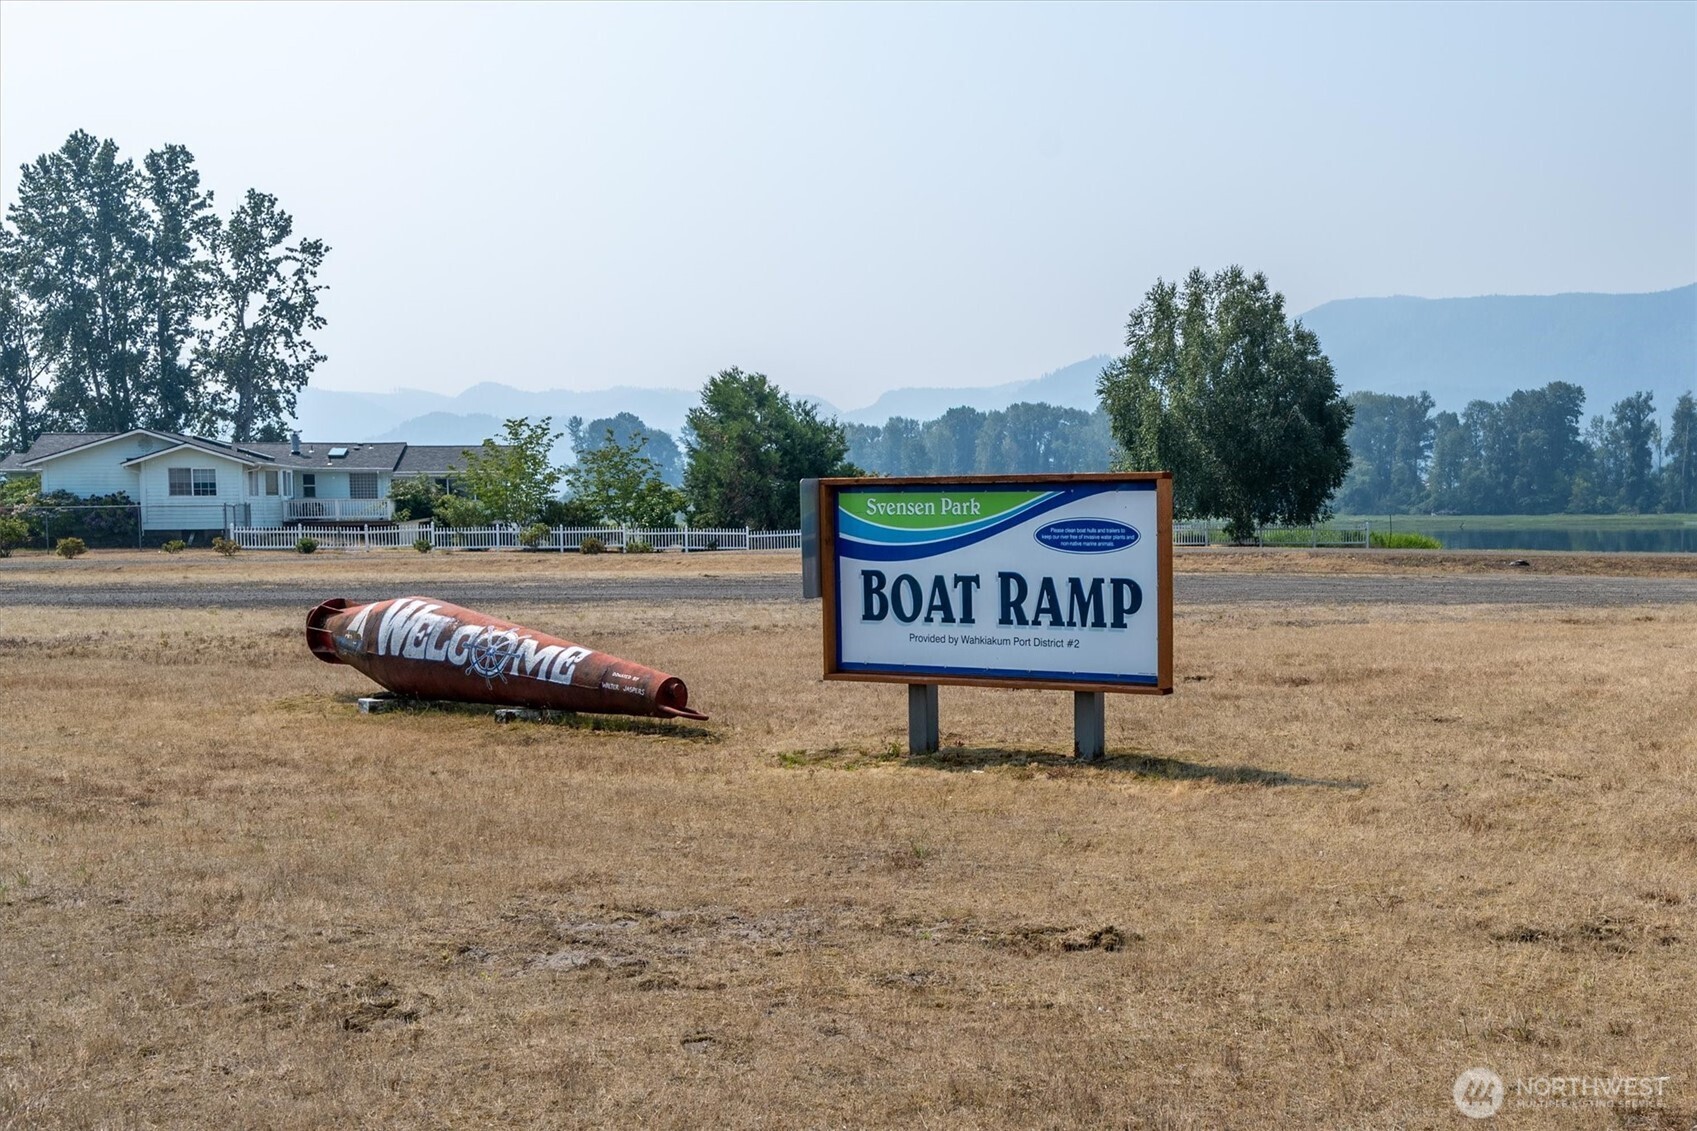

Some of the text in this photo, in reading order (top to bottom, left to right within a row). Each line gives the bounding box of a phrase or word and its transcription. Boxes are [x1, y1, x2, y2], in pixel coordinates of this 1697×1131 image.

[866, 498, 980, 515] Svensen Park
[860, 569, 1143, 629] BOAT RAMP
[378, 598, 593, 685] WELCOME
[909, 633, 1080, 648] Provided by Wahkiakum Port District #2
[601, 682, 645, 696] WALTER JASPERS
